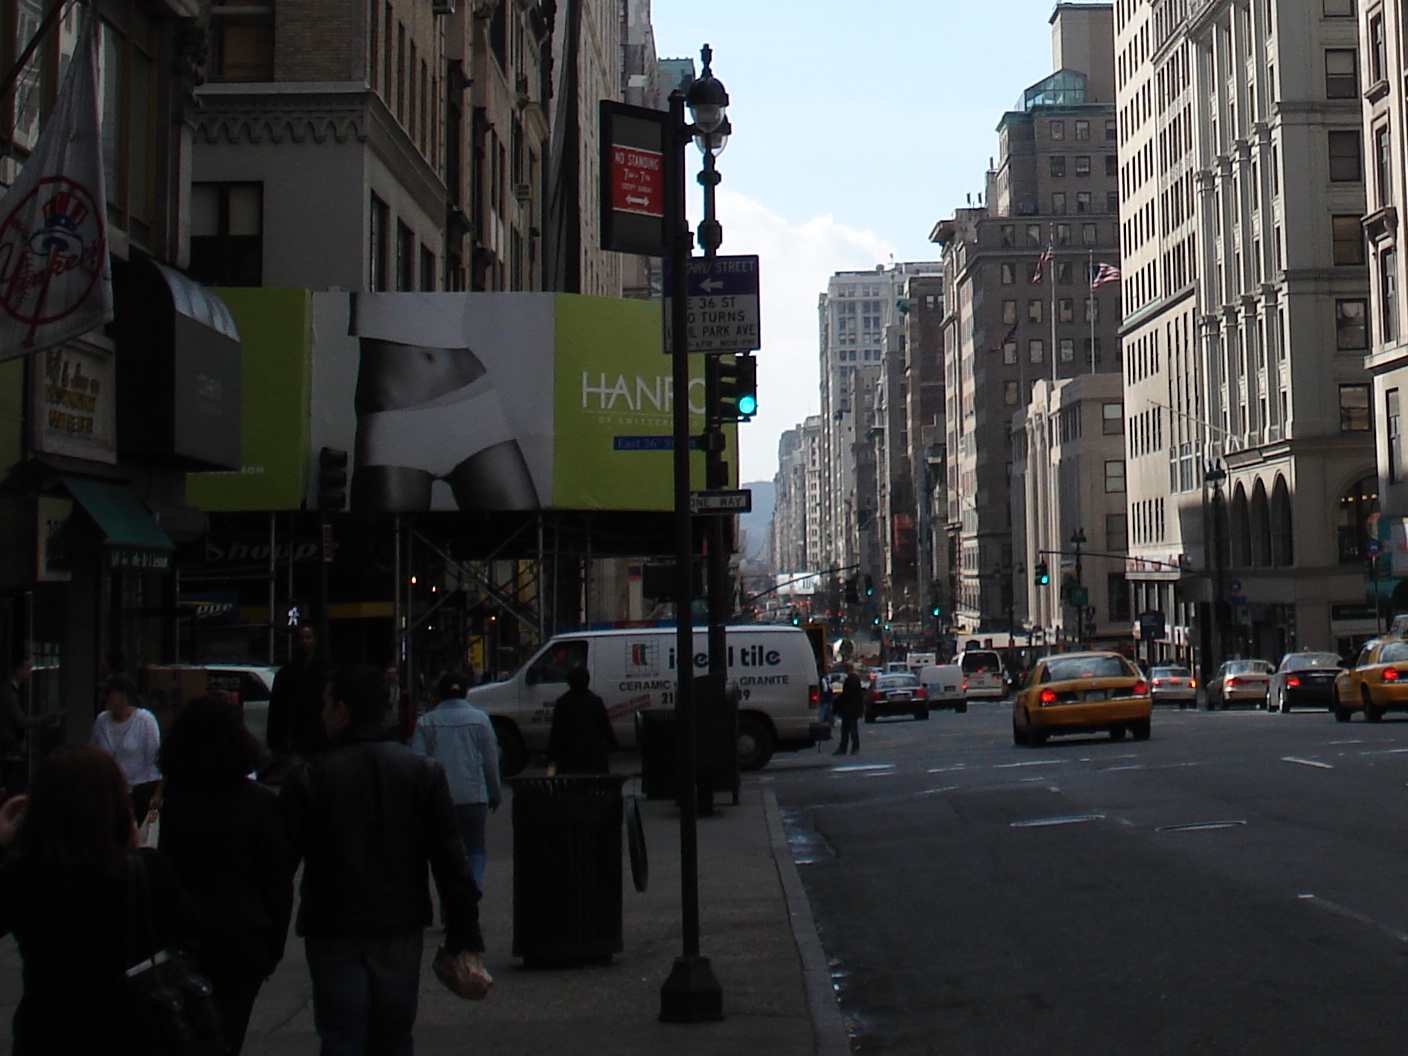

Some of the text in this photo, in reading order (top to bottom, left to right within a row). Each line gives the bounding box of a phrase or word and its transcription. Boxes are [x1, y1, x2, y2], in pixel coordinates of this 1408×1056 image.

[615, 151, 659, 170] NO STANDING
[716, 260, 754, 273] STREET
[699, 298, 715, 309] 36
[722, 297, 736, 308] ST
[702, 311, 745, 323] TURNS
[702, 326, 730, 340] PARK
[736, 323, 755, 339] AVE
[719, 496, 743, 508] WAY
[668, 645, 781, 669] iel tile
[619, 675, 790, 692] CERAMIC GRANITE
